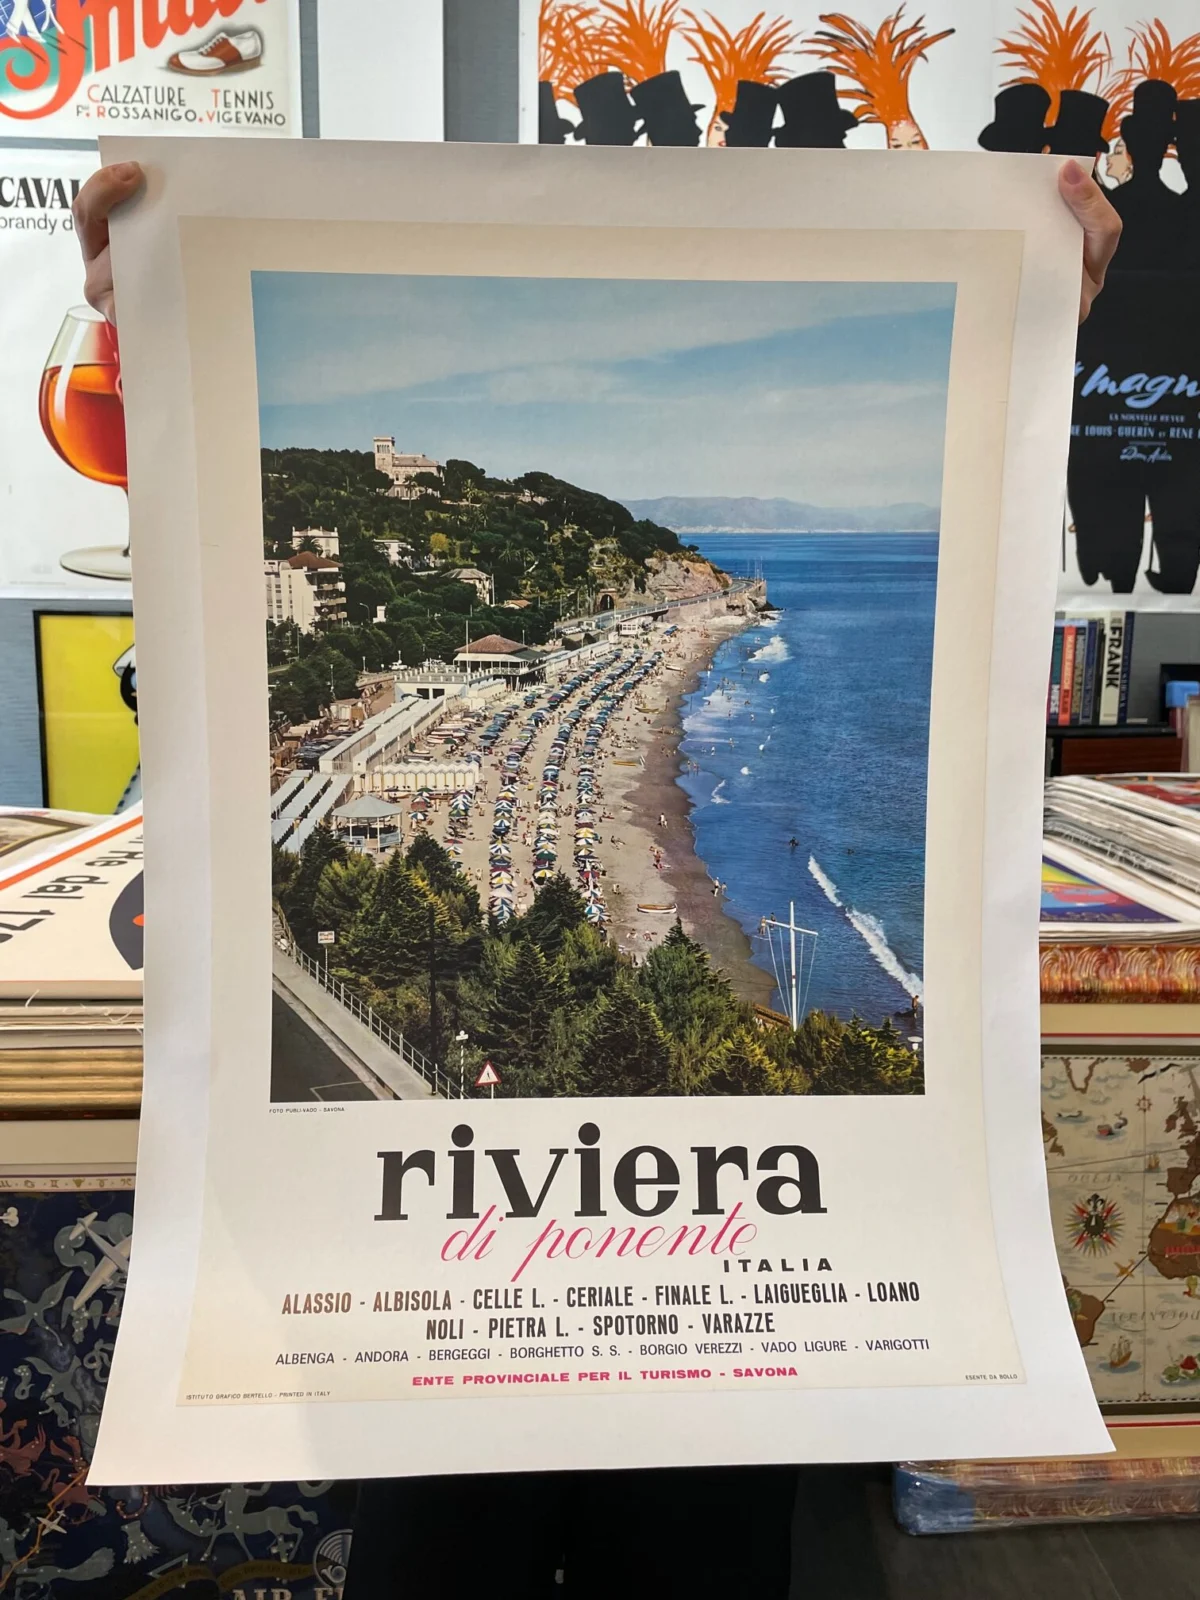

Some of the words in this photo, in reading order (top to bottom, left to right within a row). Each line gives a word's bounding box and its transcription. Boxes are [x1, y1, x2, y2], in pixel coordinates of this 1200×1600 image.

[87, 84, 186, 107] CALZATURE
[211, 88, 274, 110] TENNIS
[206, 111, 286, 126] VIGEVANO
[1106, 626, 1123, 688] FRANK
[21, 875, 109, 899] dal
[374, 1122, 827, 1221] riviera
[440, 1205, 504, 1262] di
[510, 1202, 758, 1282] ponente
[724, 1258, 832, 1272] ITALIA
[282, 1293, 351, 1314] ALASSIO
[373, 1290, 451, 1312] ALBISOLA
[473, 1288, 522, 1309] CELLE
[533, 1288, 544, 1308] L.
[567, 1286, 633, 1307] CERIALE
[656, 1285, 711, 1305] FINALE
[720, 1285, 733, 1304] L.
[754, 1283, 847, 1303] LAIGUEGLIA
[867, 1282, 919, 1302] LOANO
[427, 1319, 463, 1340] NOLI
[489, 1317, 546, 1338] PIETRA
[556, 1317, 568, 1337] L.
[594, 1314, 678, 1336] SPOTORNO
[702, 1313, 775, 1333] VARAZZE
[276, 1353, 334, 1364] ALBENGA
[355, 1351, 408, 1362] ANDORA
[429, 1348, 490, 1360] BERGEGGI
[511, 1346, 584, 1358] BORGHETTO
[592, 1346, 602, 1356] S.
[610, 1345, 620, 1356] S.
[640, 1344, 687, 1355] BORGIO
[695, 1343, 742, 1354] VEREZZI
[761, 1342, 796, 1352] VADO
[805, 1341, 847, 1352] LIGURE
[866, 1339, 929, 1350] VARIGOTTI
[413, 1376, 453, 1385] ENTE
[463, 1373, 569, 1384] PROVINCIALE
[579, 1372, 610, 1381] PER
[619, 1372, 632, 1380] IL
[640, 1369, 711, 1379] TURISMO
[733, 1367, 797, 1377] SAVONA
